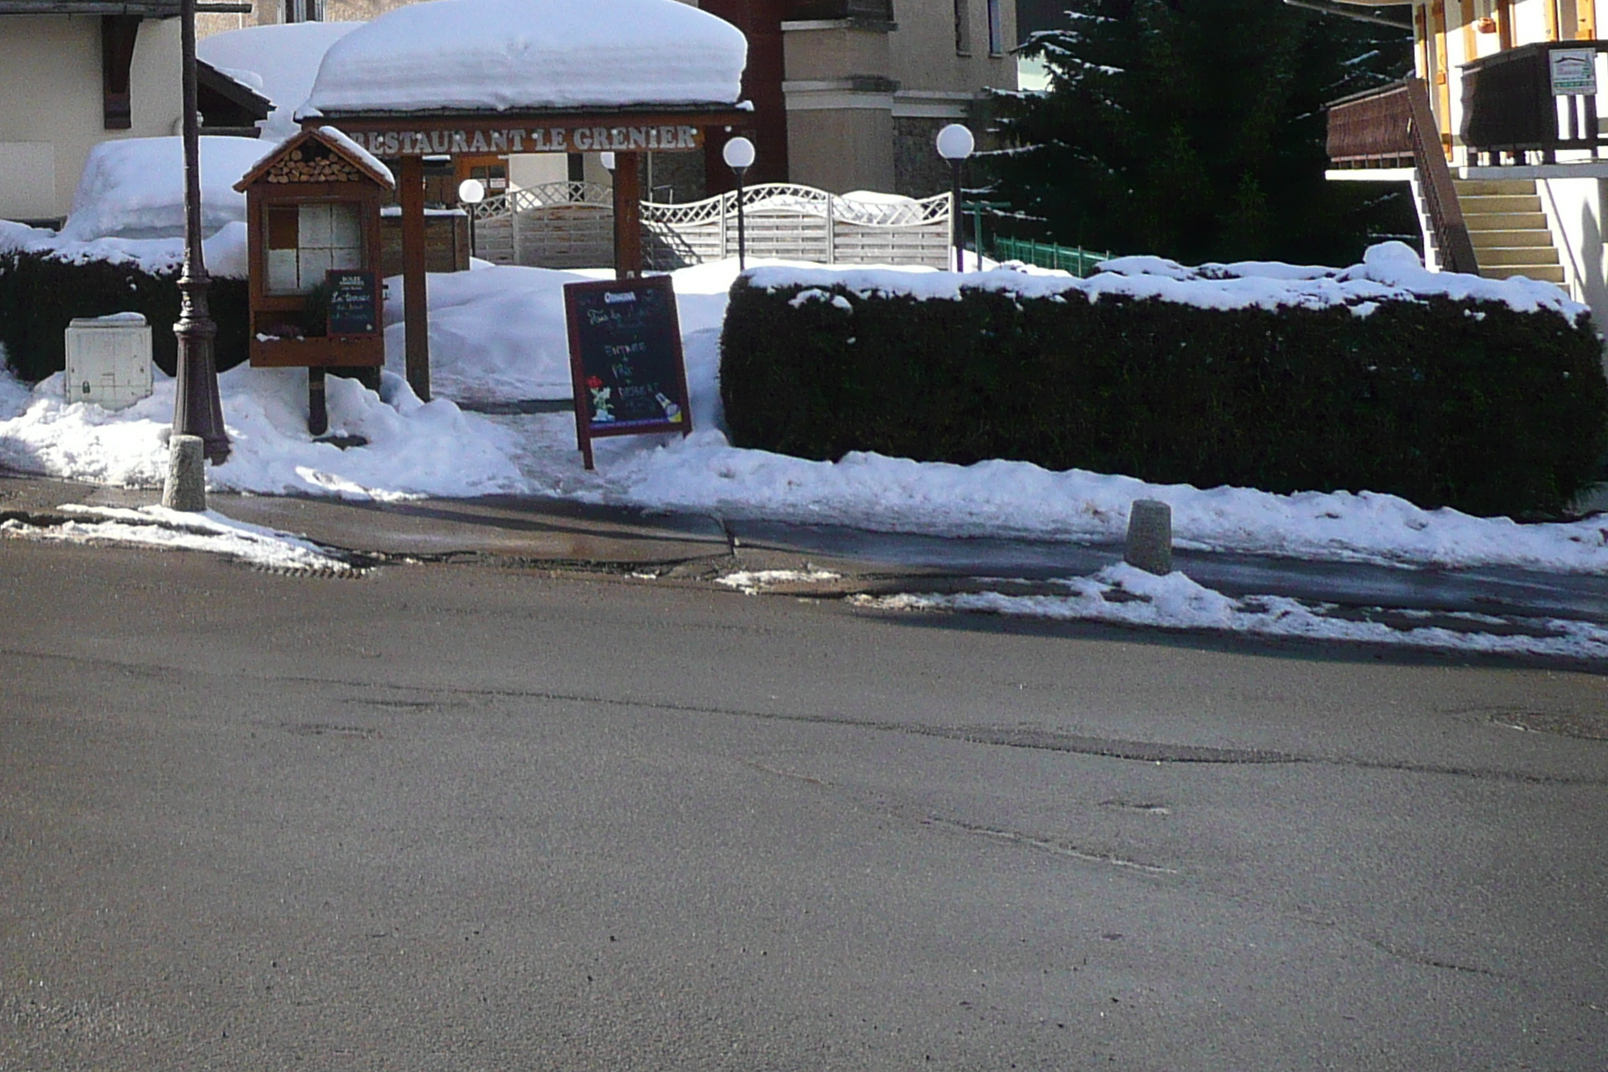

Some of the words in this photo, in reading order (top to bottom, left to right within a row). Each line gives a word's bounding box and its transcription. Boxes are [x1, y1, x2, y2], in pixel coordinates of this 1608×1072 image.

[349, 129, 527, 155] RESTAURANT
[534, 129, 568, 152] LE
[573, 125, 696, 150] GRENIER
